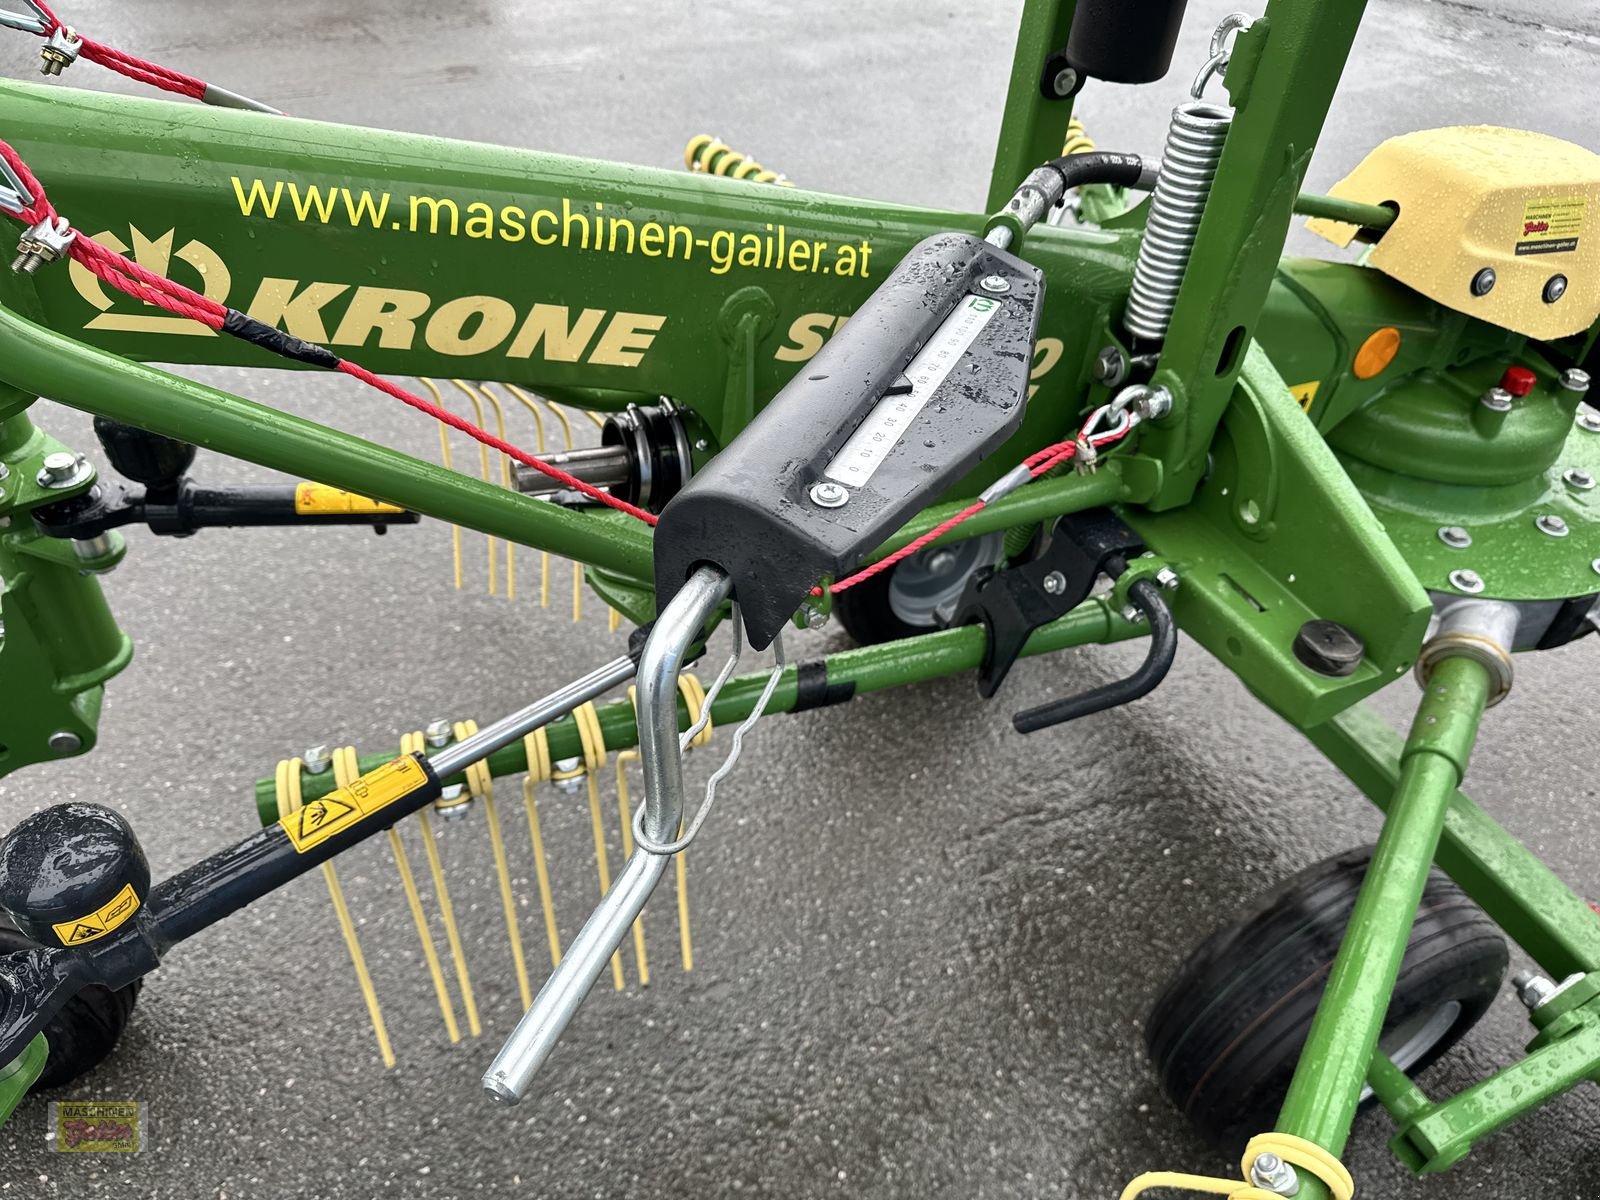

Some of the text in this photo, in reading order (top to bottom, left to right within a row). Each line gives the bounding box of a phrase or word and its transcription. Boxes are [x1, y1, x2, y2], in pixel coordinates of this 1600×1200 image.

[231, 176, 873, 278] www.maschinen-gailer.at
[246, 277, 667, 368] KRONE
[928, 363, 940, 371] 70
[917, 375, 930, 385] 60
[895, 403, 908, 412] 40
[884, 417, 897, 427] 30
[872, 432, 886, 442] 20
[860, 448, 873, 458] 10
